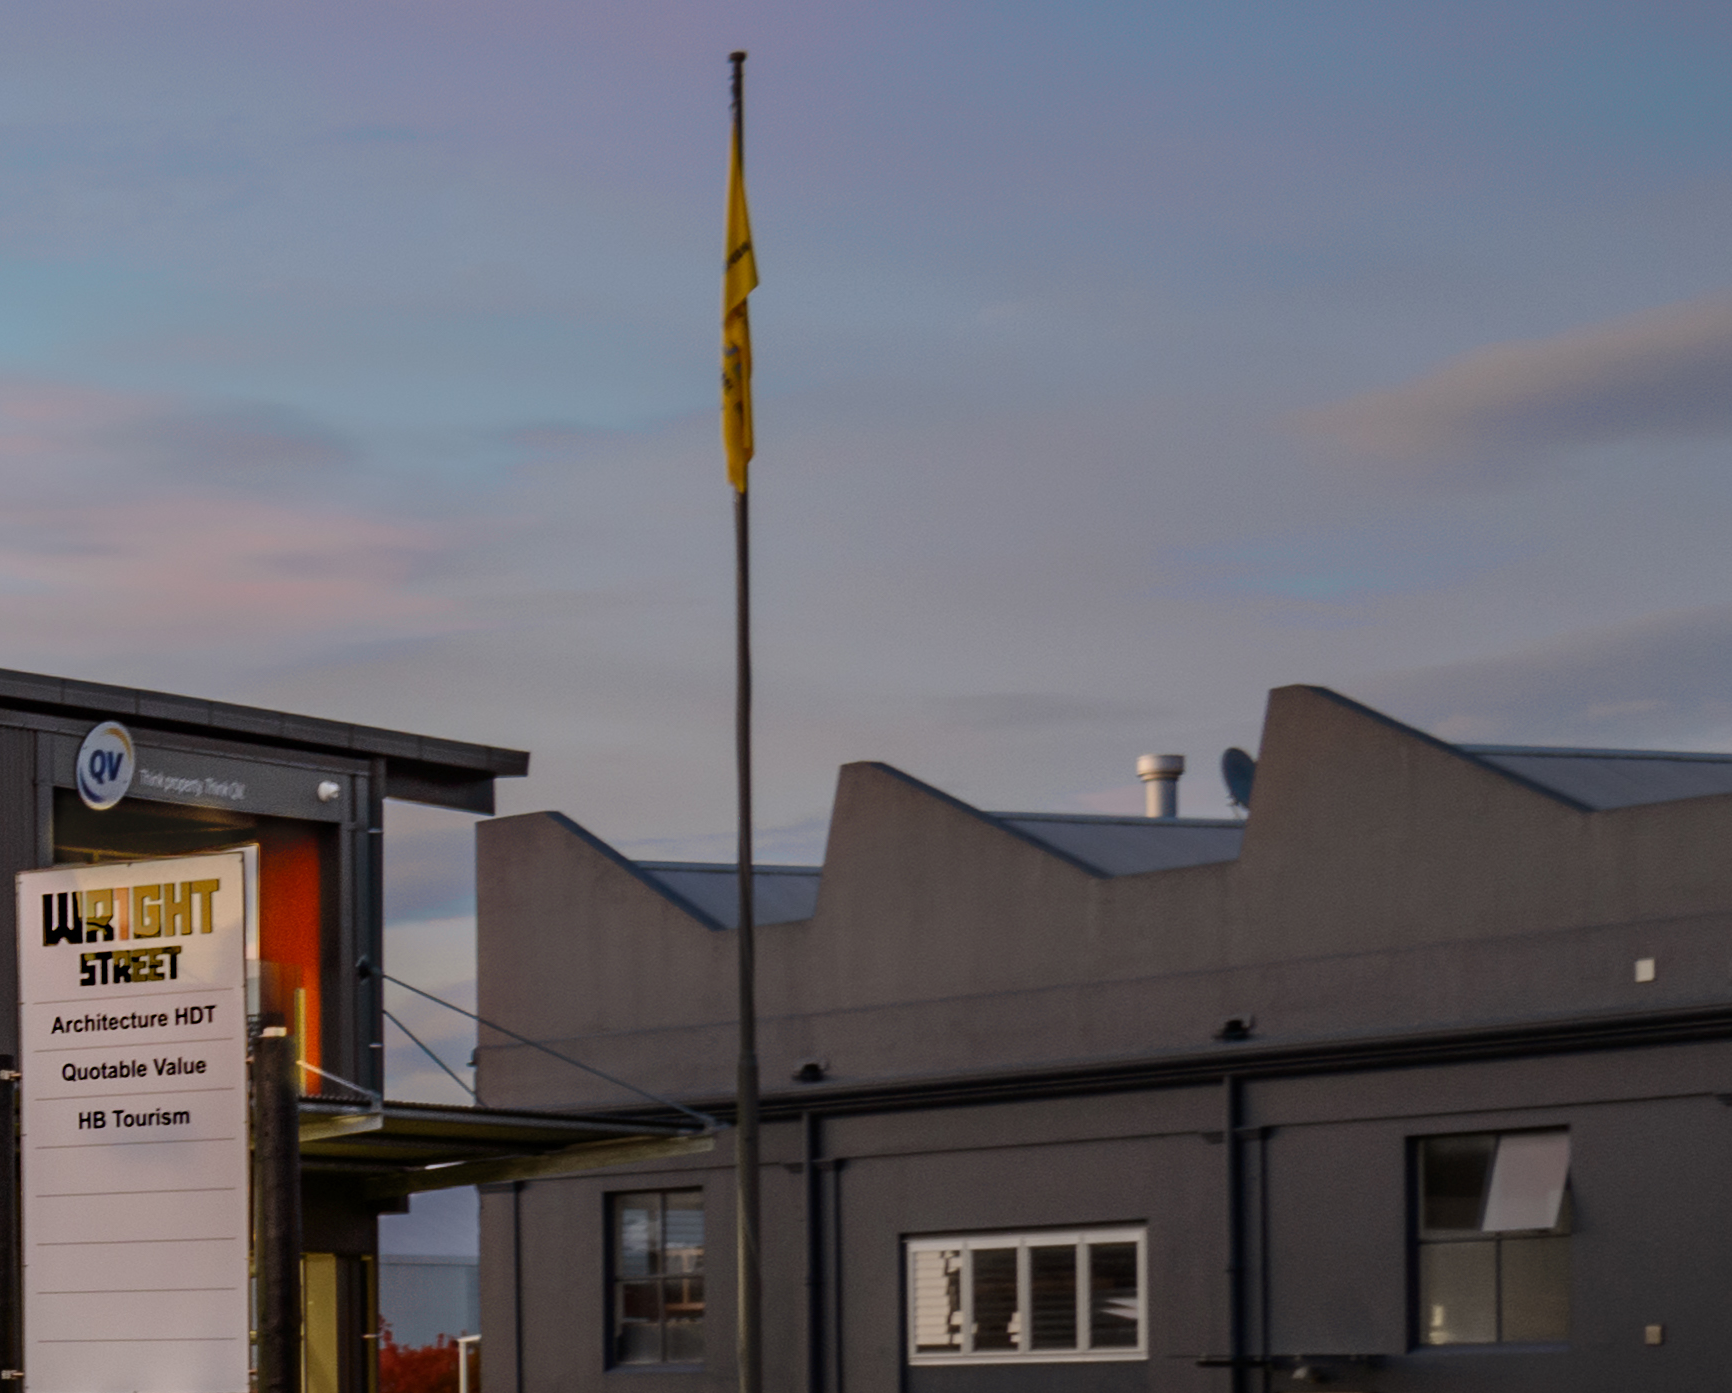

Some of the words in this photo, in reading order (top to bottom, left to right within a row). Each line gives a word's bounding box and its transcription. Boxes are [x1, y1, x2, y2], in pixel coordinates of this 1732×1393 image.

[89, 749, 124, 784] QV
[80, 946, 181, 986] STREET
[51, 1010, 168, 1035] Architecture
[175, 1005, 217, 1026] HDT
[61, 1058, 148, 1083] Quotable
[154, 1056, 208, 1076] Value
[78, 1110, 106, 1130] HB
[112, 1106, 191, 1128] Tourism
